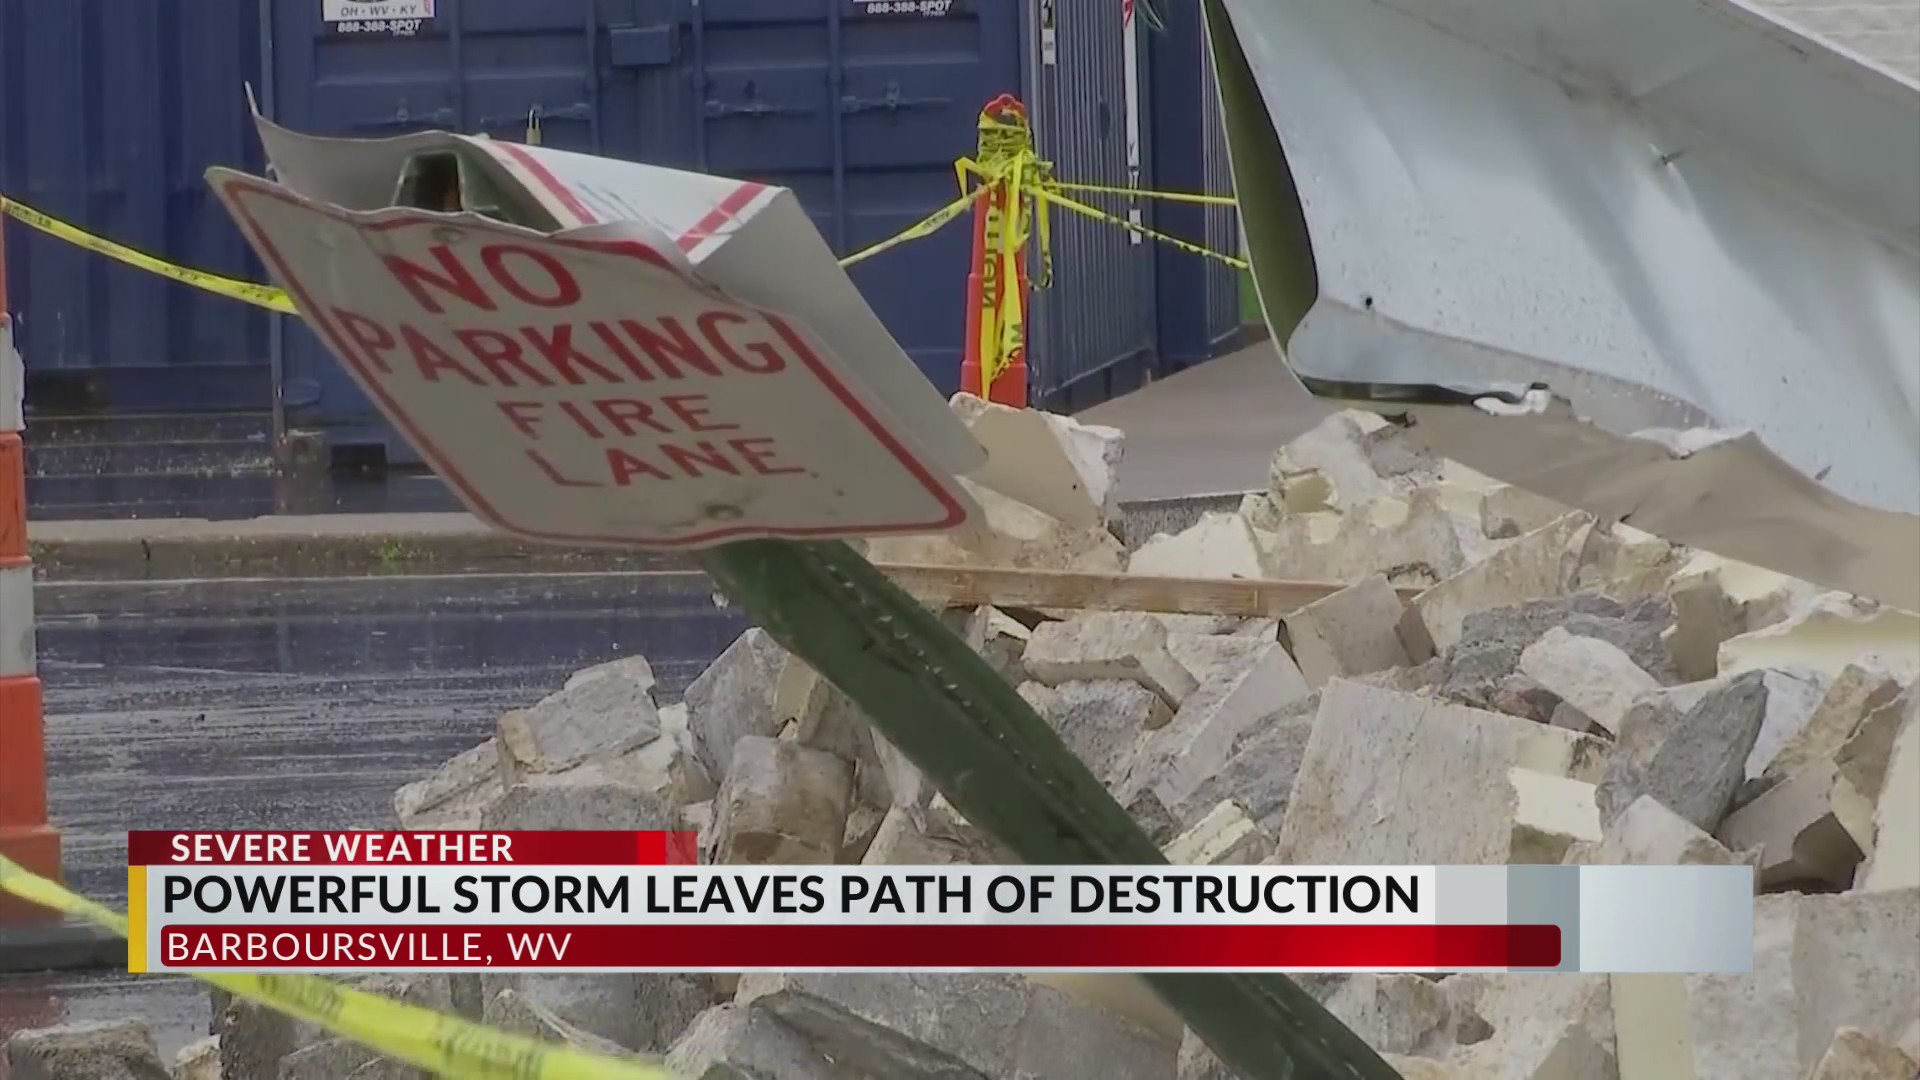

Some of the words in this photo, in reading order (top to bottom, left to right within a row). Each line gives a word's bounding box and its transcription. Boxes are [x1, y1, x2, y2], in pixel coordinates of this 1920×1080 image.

[337, 19, 422, 33] 888-388-SPOT
[340, 6, 359, 17] OH
[369, 5, 390, 15] WV
[400, 5, 417, 14] KY
[383, 244, 582, 314] NO
[332, 310, 787, 388] PARKING
[495, 393, 741, 440] FIRE
[525, 436, 808, 487] LANE
